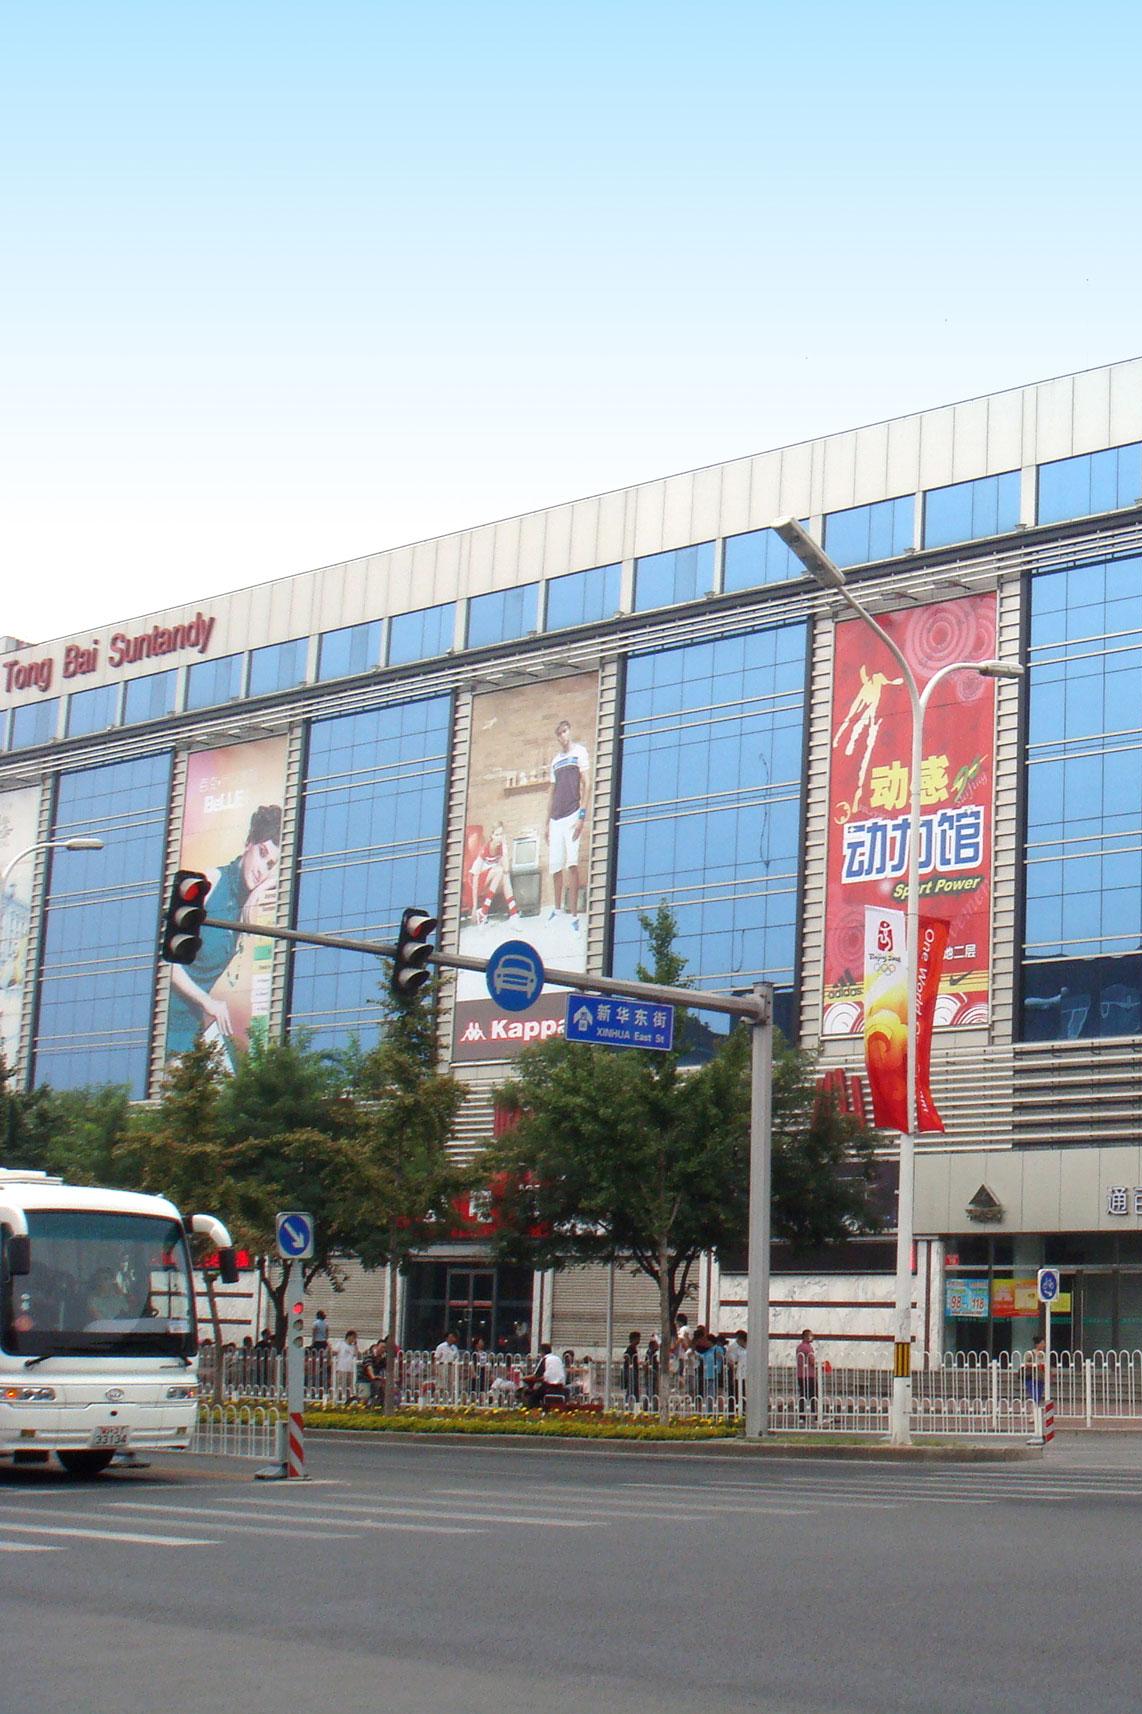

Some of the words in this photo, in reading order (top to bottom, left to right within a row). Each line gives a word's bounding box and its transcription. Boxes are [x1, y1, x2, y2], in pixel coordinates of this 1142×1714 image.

[3, 658, 53, 693] Tong
[63, 639, 99, 678] Bai
[108, 612, 215, 667] Suntandy
[870, 755, 949, 810] 动感
[844, 807, 983, 882] 动力馆
[894, 881, 931, 898] Sprt
[935, 877, 981, 893] Power
[922, 929, 935, 962] One
[596, 1004, 667, 1028] 新华东街
[596, 1027, 631, 1039] XINHUA
[634, 1031, 652, 1042] East
[655, 1034, 665, 1043] St
